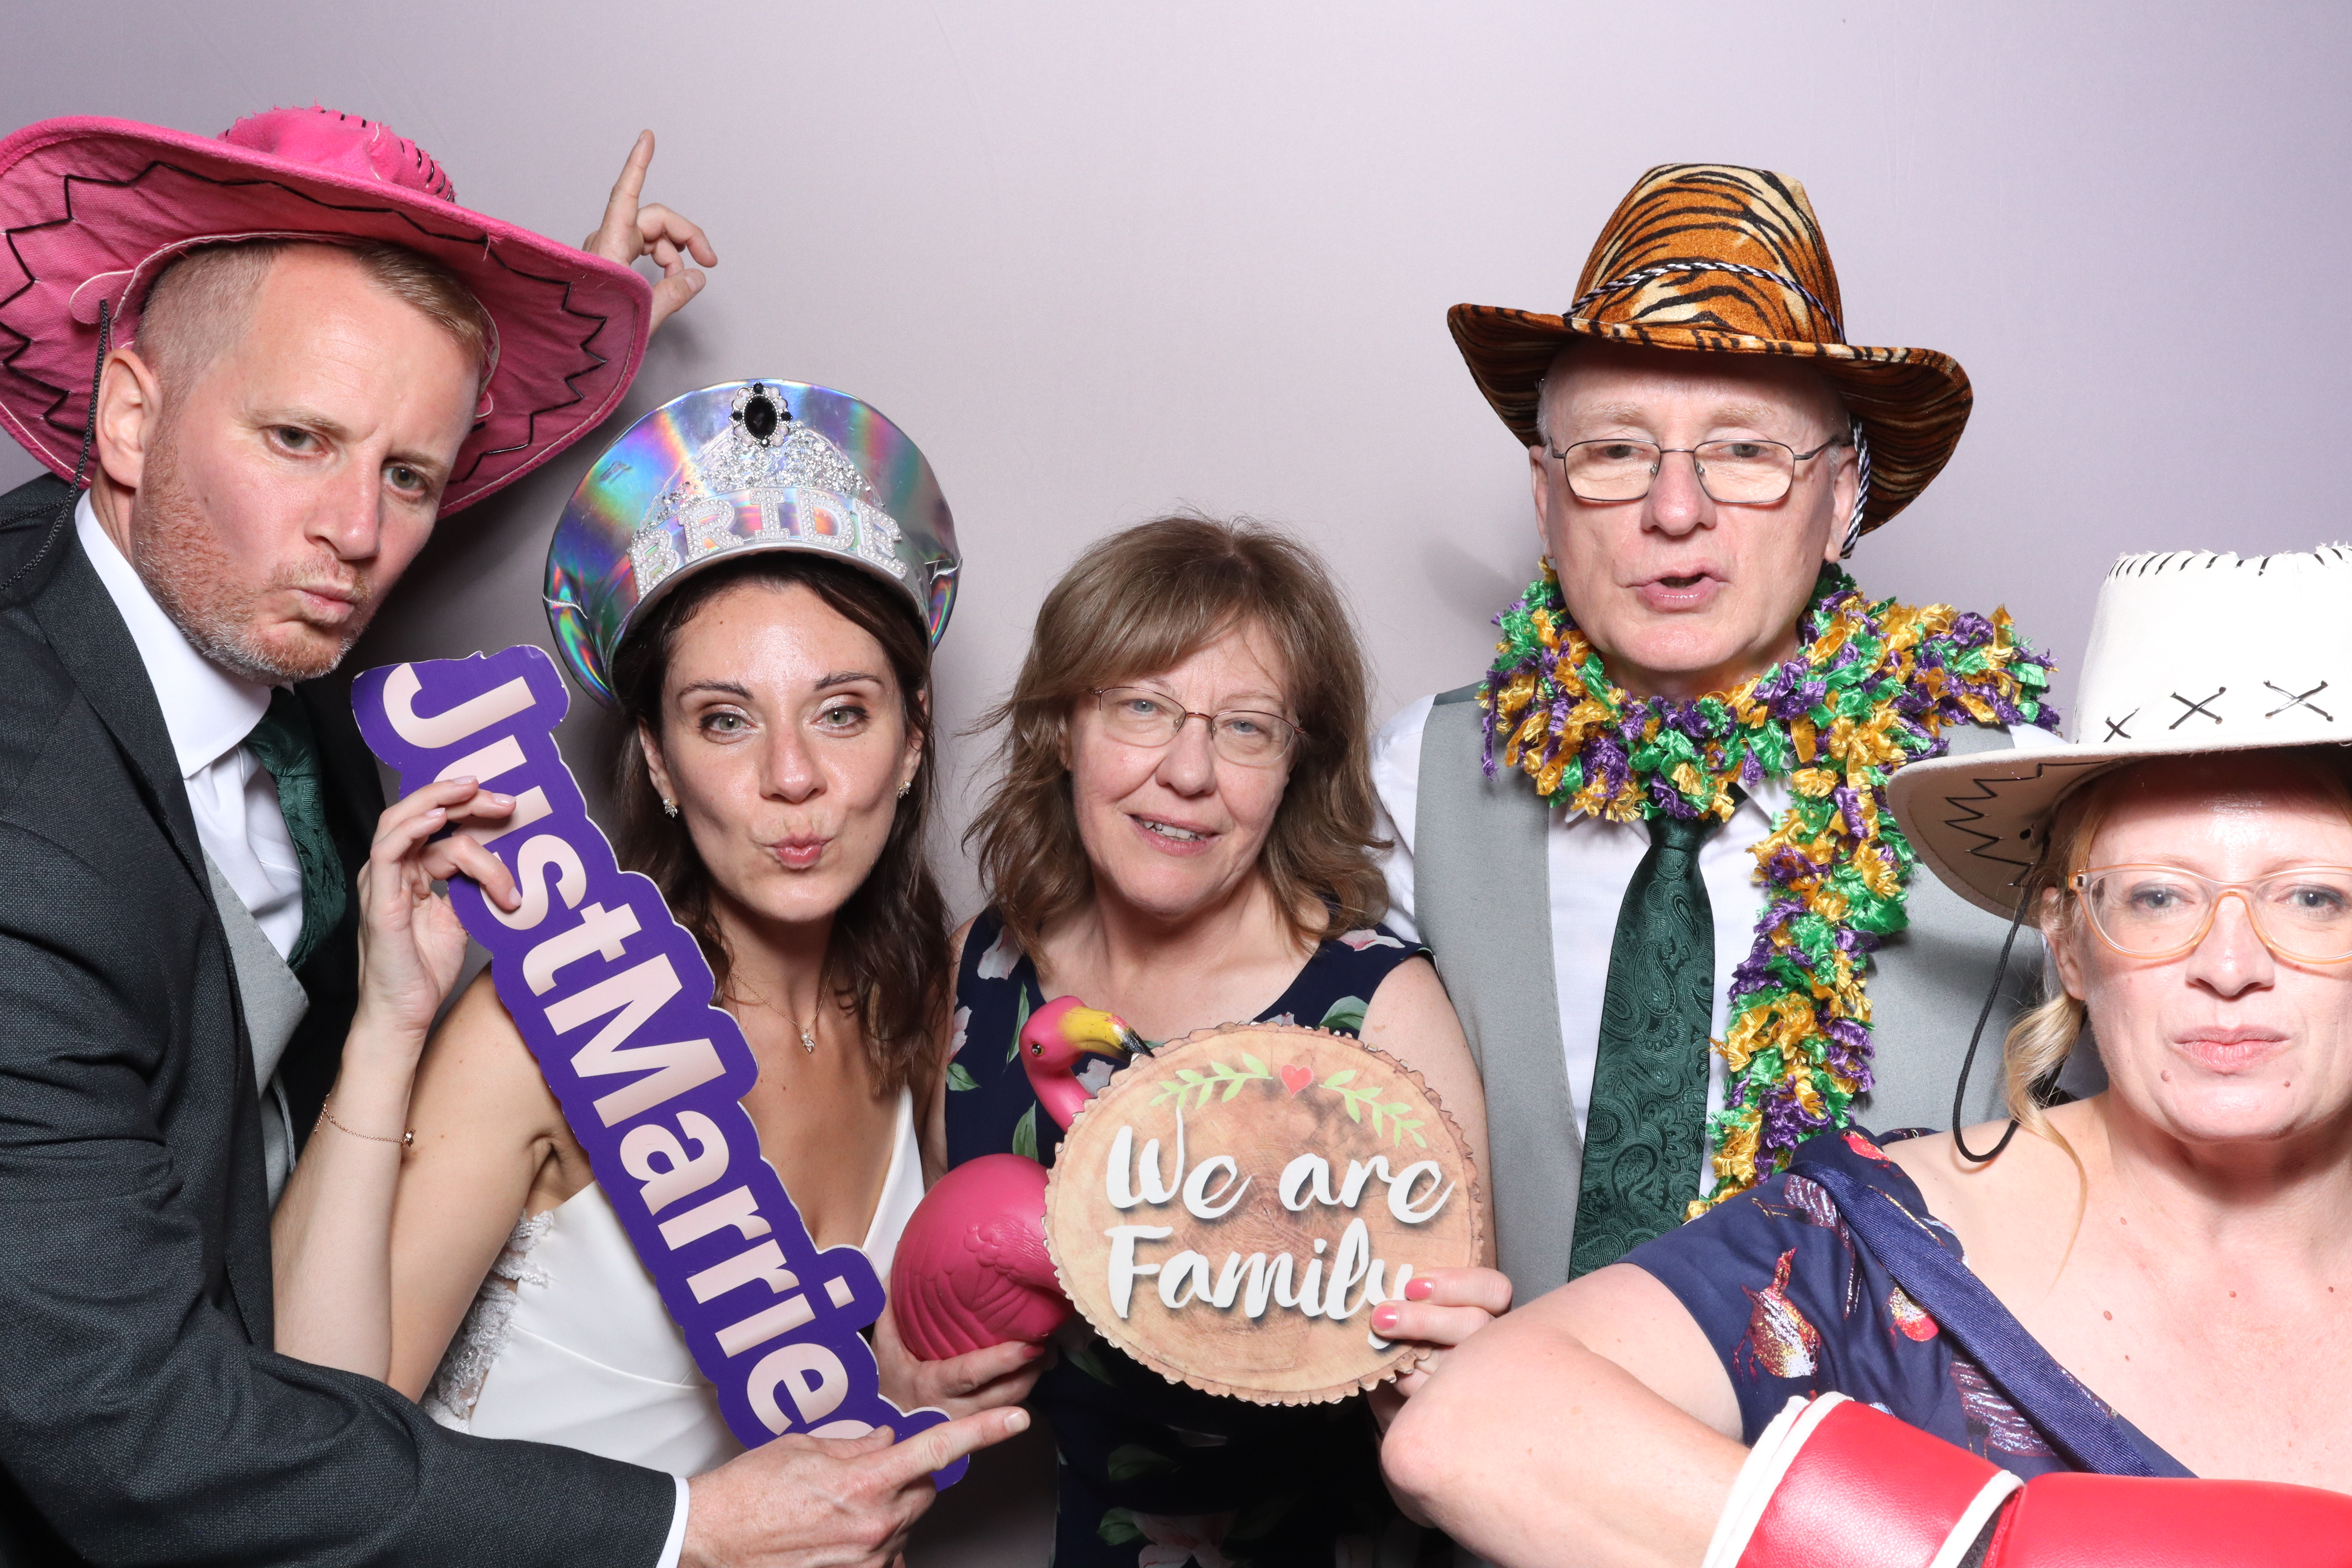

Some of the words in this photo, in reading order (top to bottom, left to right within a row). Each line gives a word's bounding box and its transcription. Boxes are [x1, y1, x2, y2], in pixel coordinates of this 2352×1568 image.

[626, 489, 909, 602] BRIDE
[1106, 1106, 1252, 1219] We
[1279, 1153, 1455, 1223] are
[1104, 1218, 1413, 1349] Family
